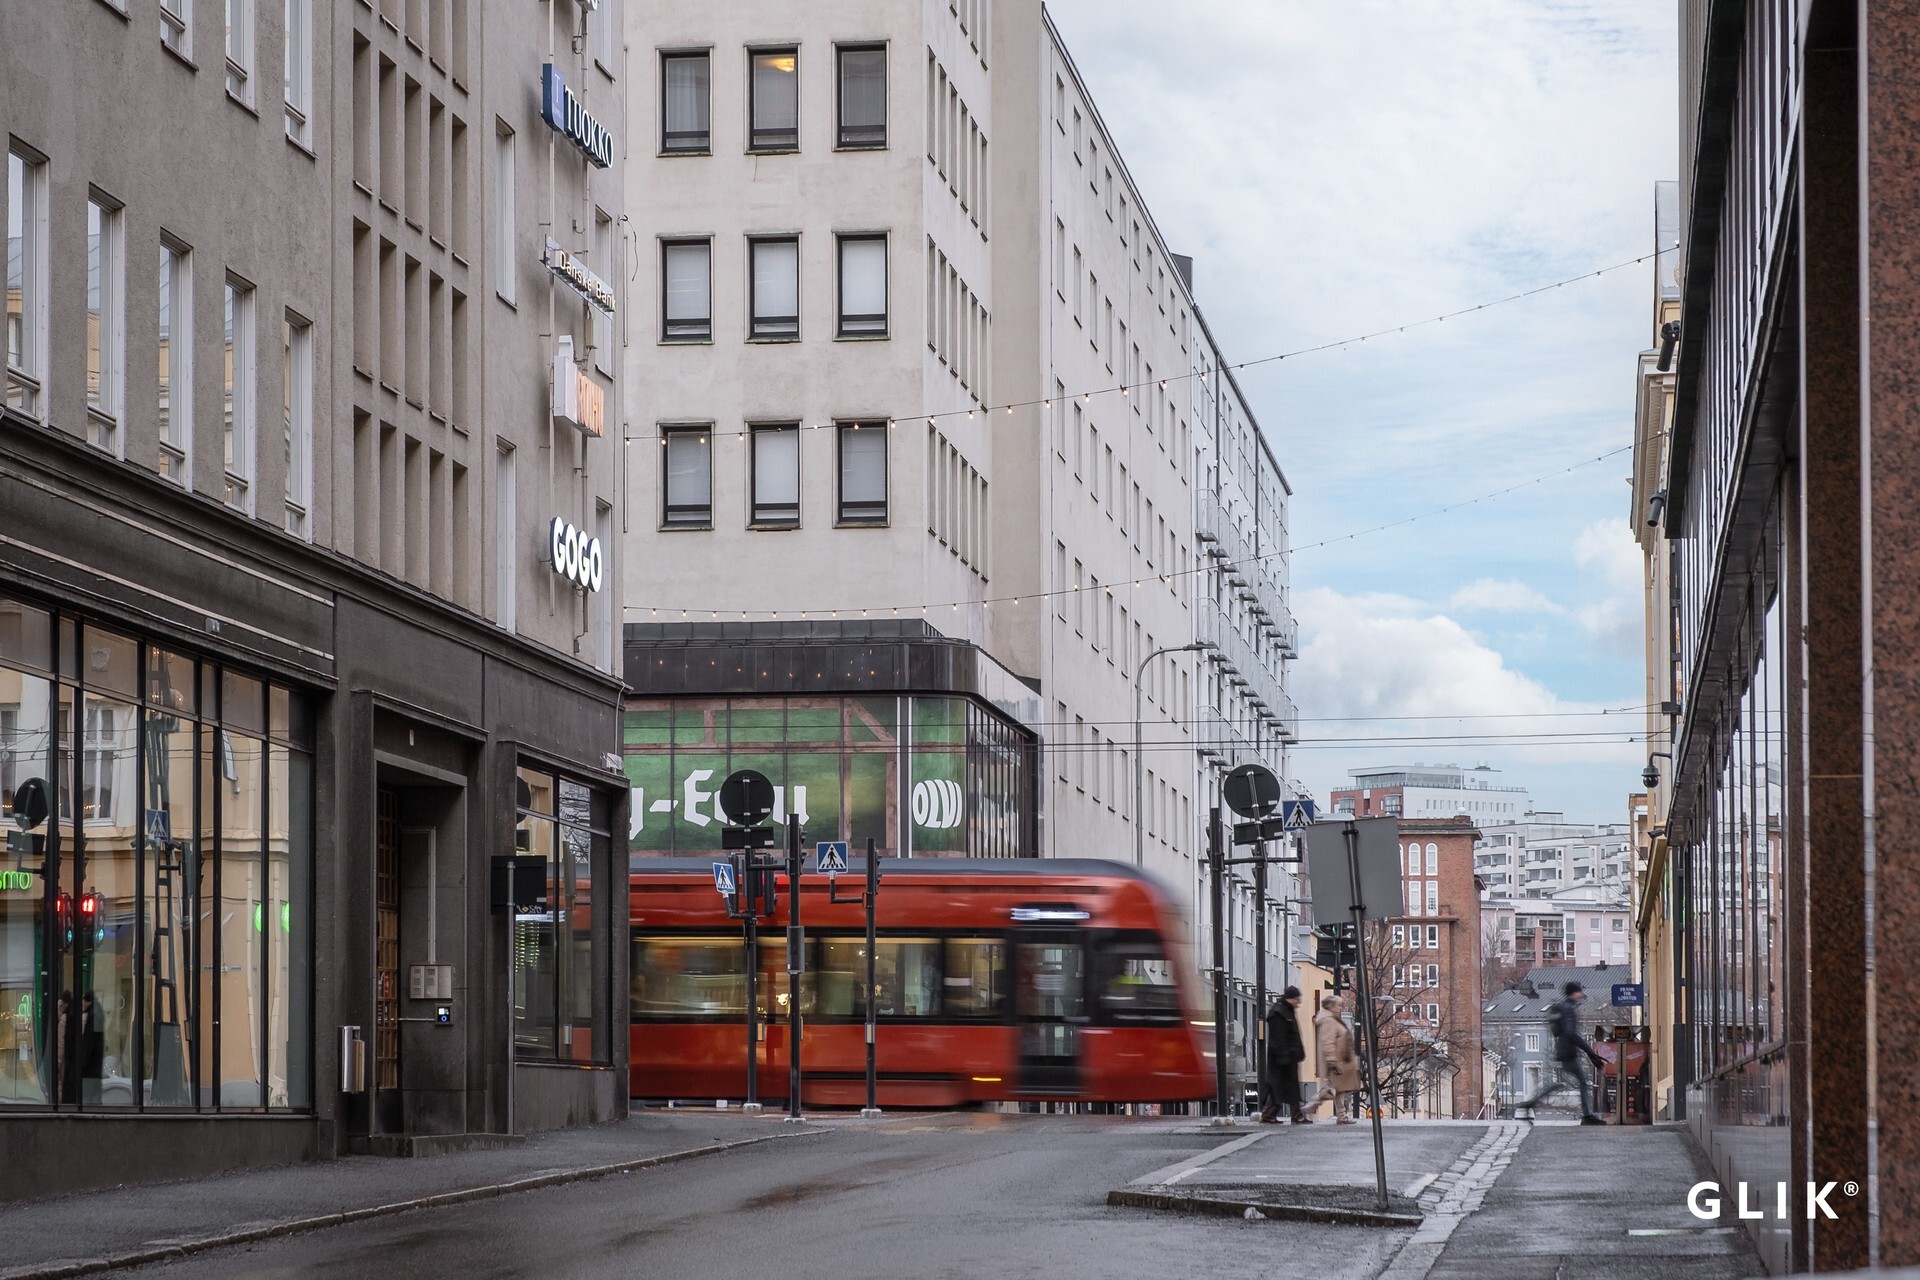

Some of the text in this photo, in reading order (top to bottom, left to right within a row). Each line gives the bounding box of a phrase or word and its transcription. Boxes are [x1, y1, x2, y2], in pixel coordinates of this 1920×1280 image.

[564, 85, 614, 169] TUOKKO
[559, 250, 617, 311] Danske Bank
[551, 516, 603, 593] GOGO
[912, 779, 963, 829] OLVI
